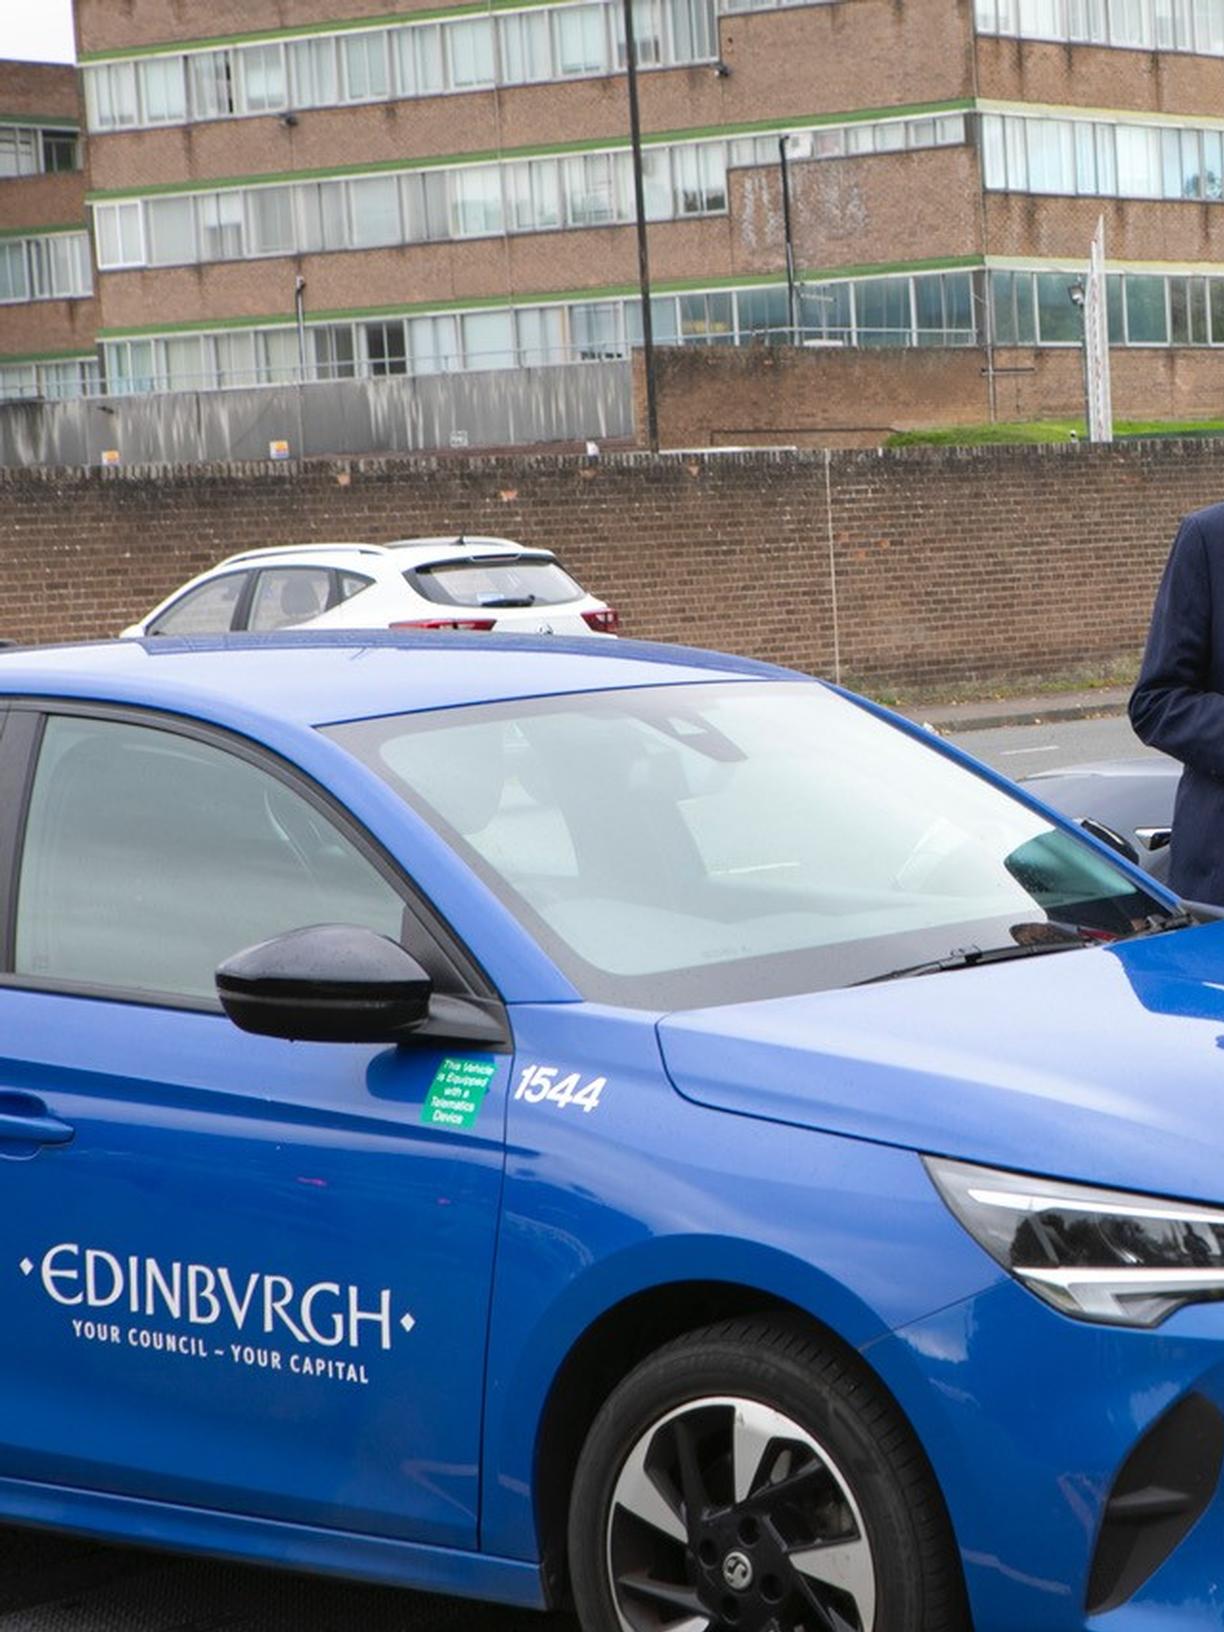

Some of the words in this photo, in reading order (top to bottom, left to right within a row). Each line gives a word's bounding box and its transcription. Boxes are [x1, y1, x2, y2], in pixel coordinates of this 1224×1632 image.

[443, 1059, 461, 1071] This
[463, 1062, 494, 1076] Vehicle
[446, 1072, 489, 1087] Equipped
[444, 1088, 462, 1097] with
[463, 1090, 470, 1098] a
[514, 1064, 607, 1113] 1544
[431, 1096, 475, 1112] Telematics
[432, 1110, 463, 1124] Device
[41, 1243, 391, 1349] EDINBVRGH
[72, 1319, 121, 1343] YOUR
[128, 1328, 207, 1357] COUNCIL
[231, 1344, 281, 1370] YOUR
[290, 1354, 369, 1384] CAPITAL
